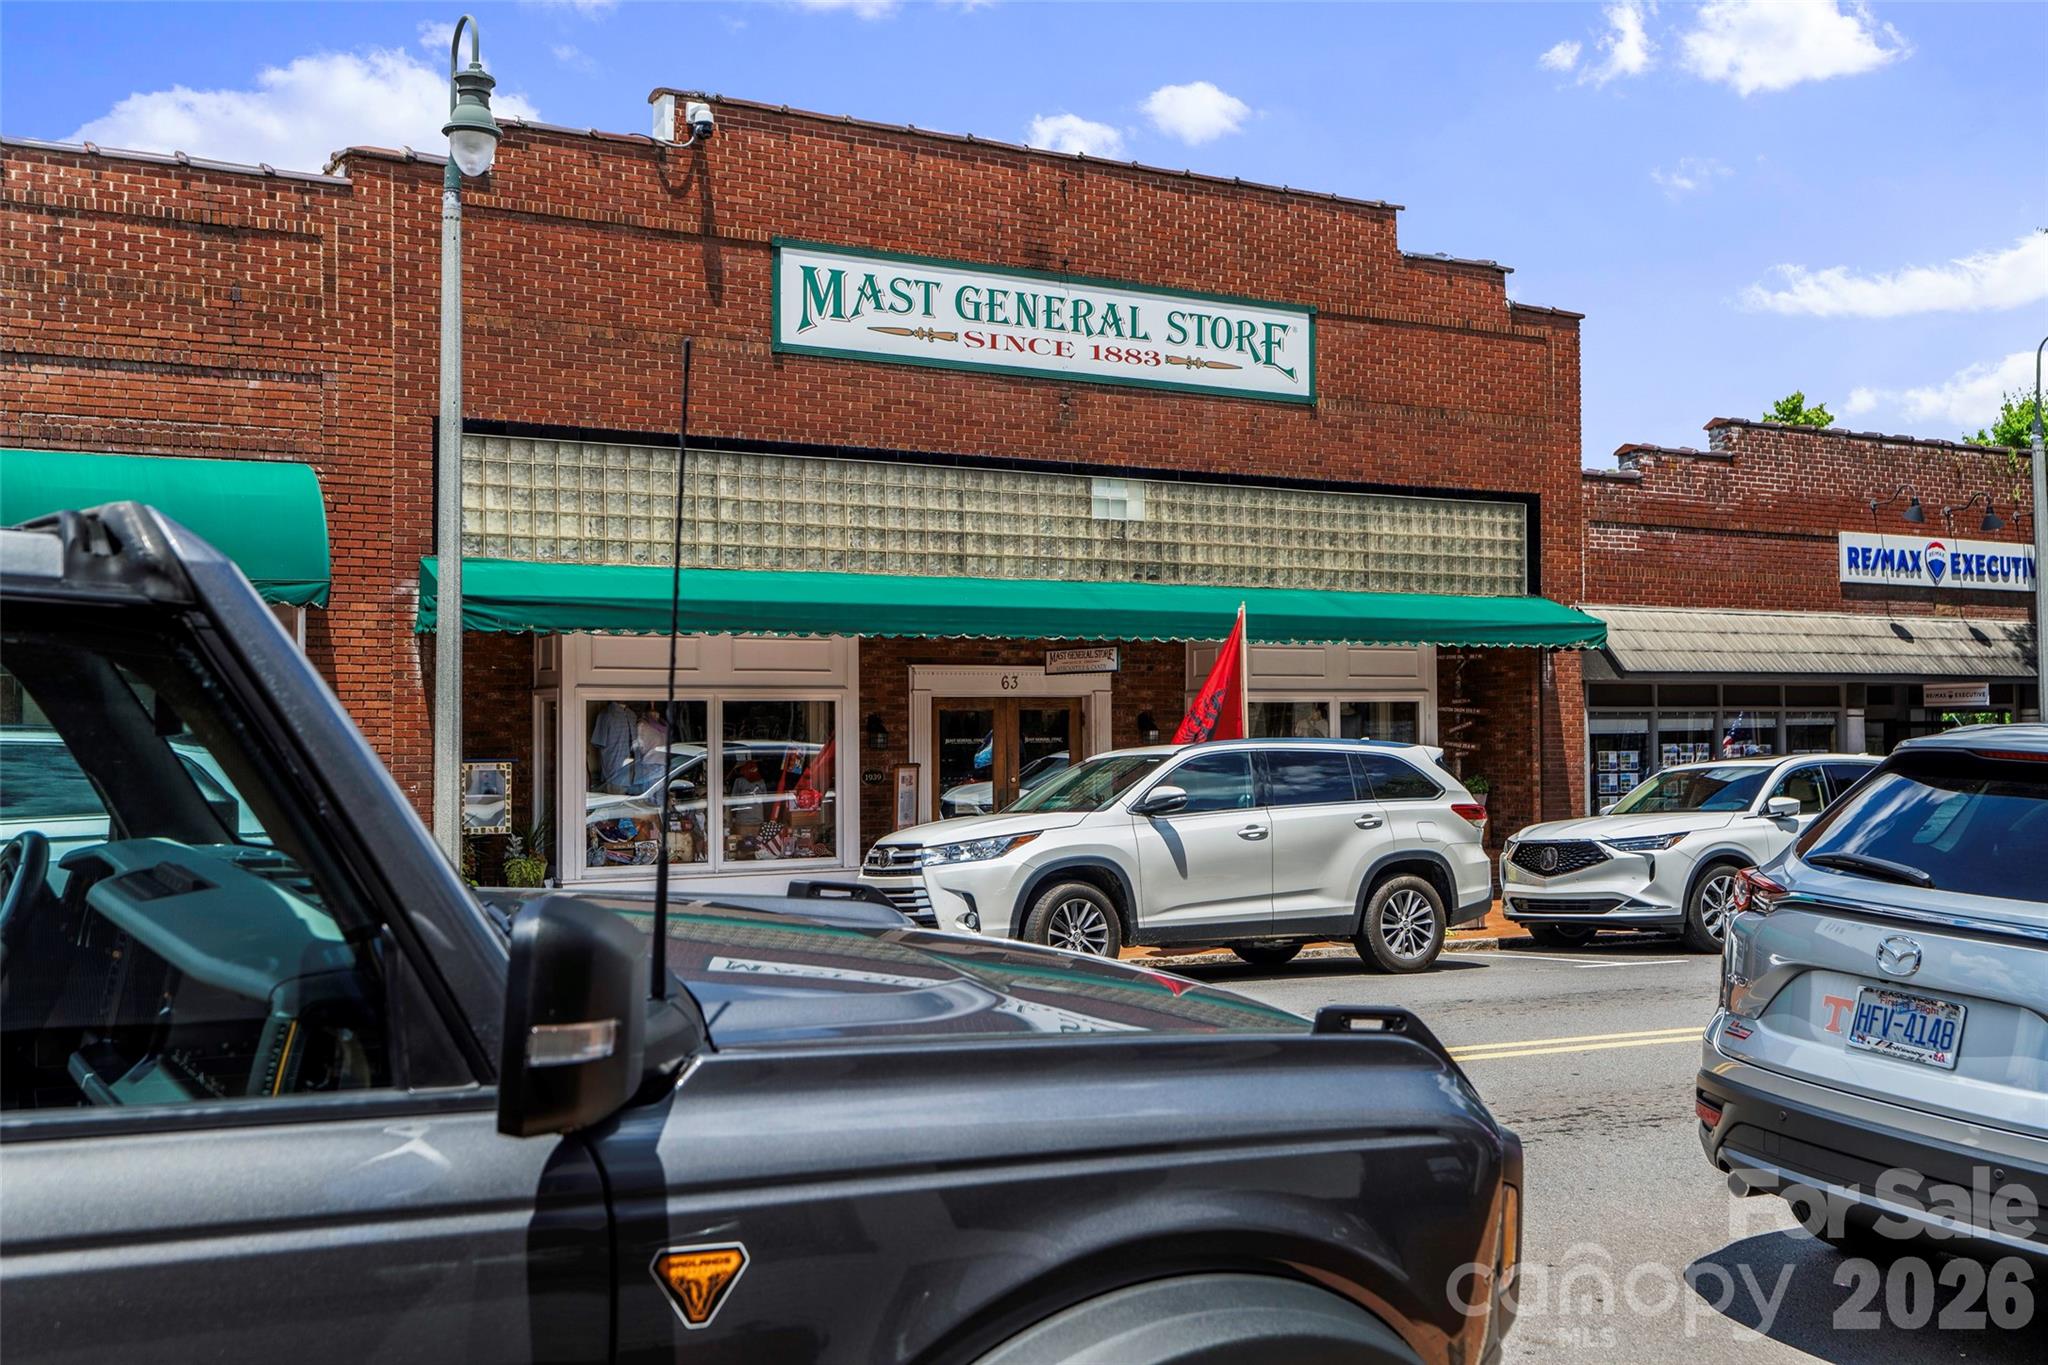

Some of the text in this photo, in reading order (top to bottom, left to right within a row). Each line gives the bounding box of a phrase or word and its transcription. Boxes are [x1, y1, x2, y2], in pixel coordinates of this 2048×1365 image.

[796, 265, 1298, 384] MAST GENERAL STORE
[963, 330, 1162, 367] SINCE 1883
[1847, 546, 1922, 572] RE/MAX
[1049, 652, 1067, 665] MAST
[1067, 650, 1094, 660] GENERAL
[1095, 649, 1114, 661] STORE
[1001, 675, 1019, 690] 63
[865, 773, 882, 781] 1939
[1823, 995, 1855, 1034] T
[1915, 1002, 1940, 1016] Flight
[1855, 1002, 1956, 1051] HFV-4148
